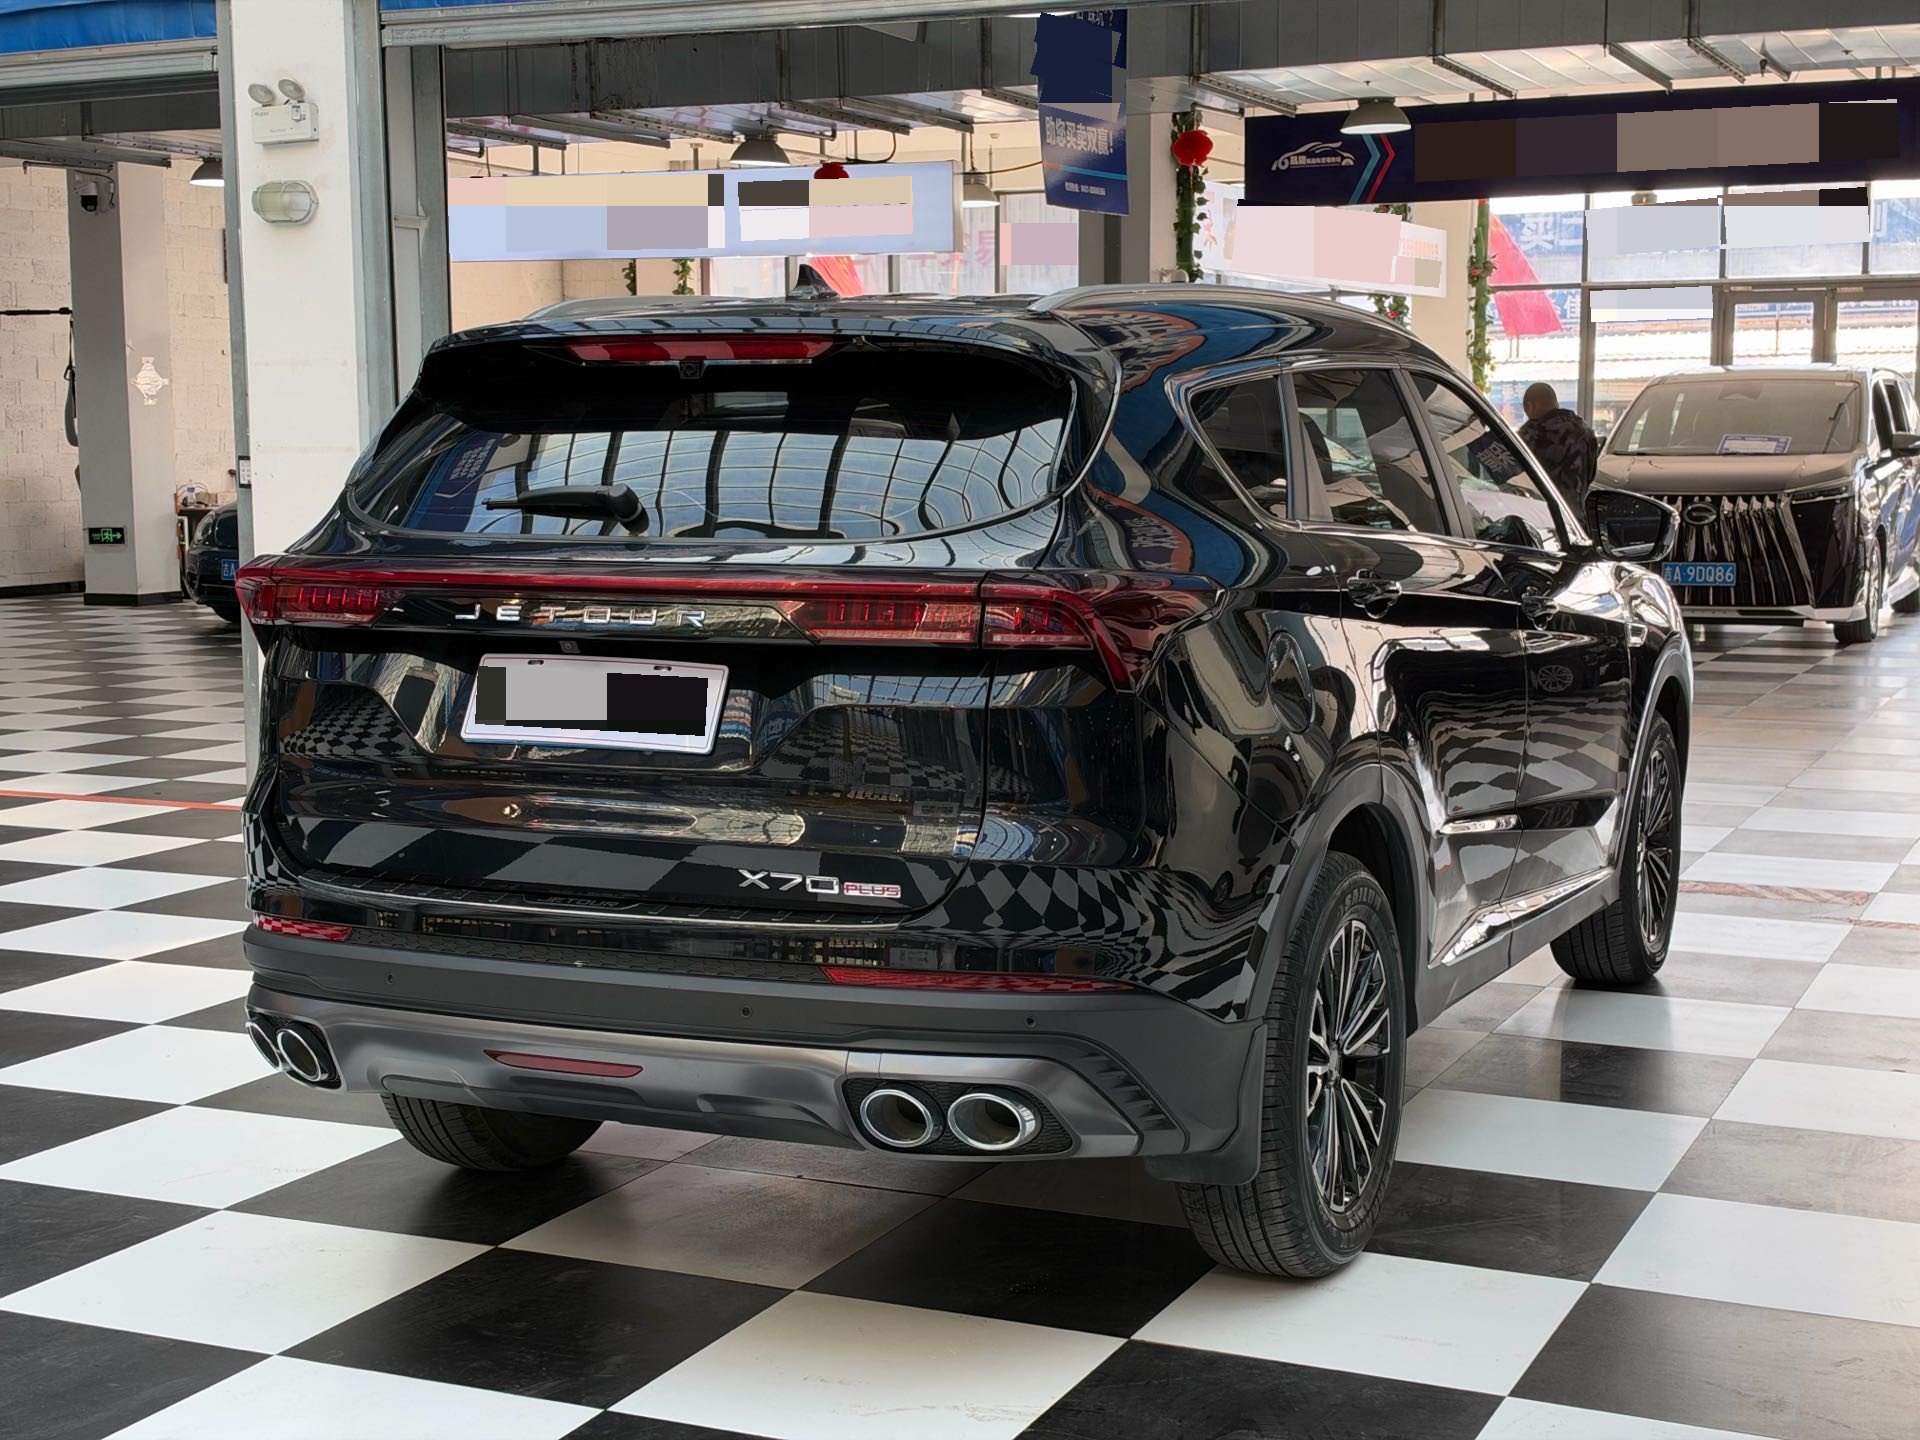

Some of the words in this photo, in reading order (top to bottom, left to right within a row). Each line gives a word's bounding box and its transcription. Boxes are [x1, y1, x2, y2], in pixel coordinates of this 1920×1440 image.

[1045, 116, 1113, 156] 助您买卖双赢！
[454, 603, 706, 628] JETOUR
[738, 869, 840, 895] X70
[844, 882, 901, 898] PLUS
